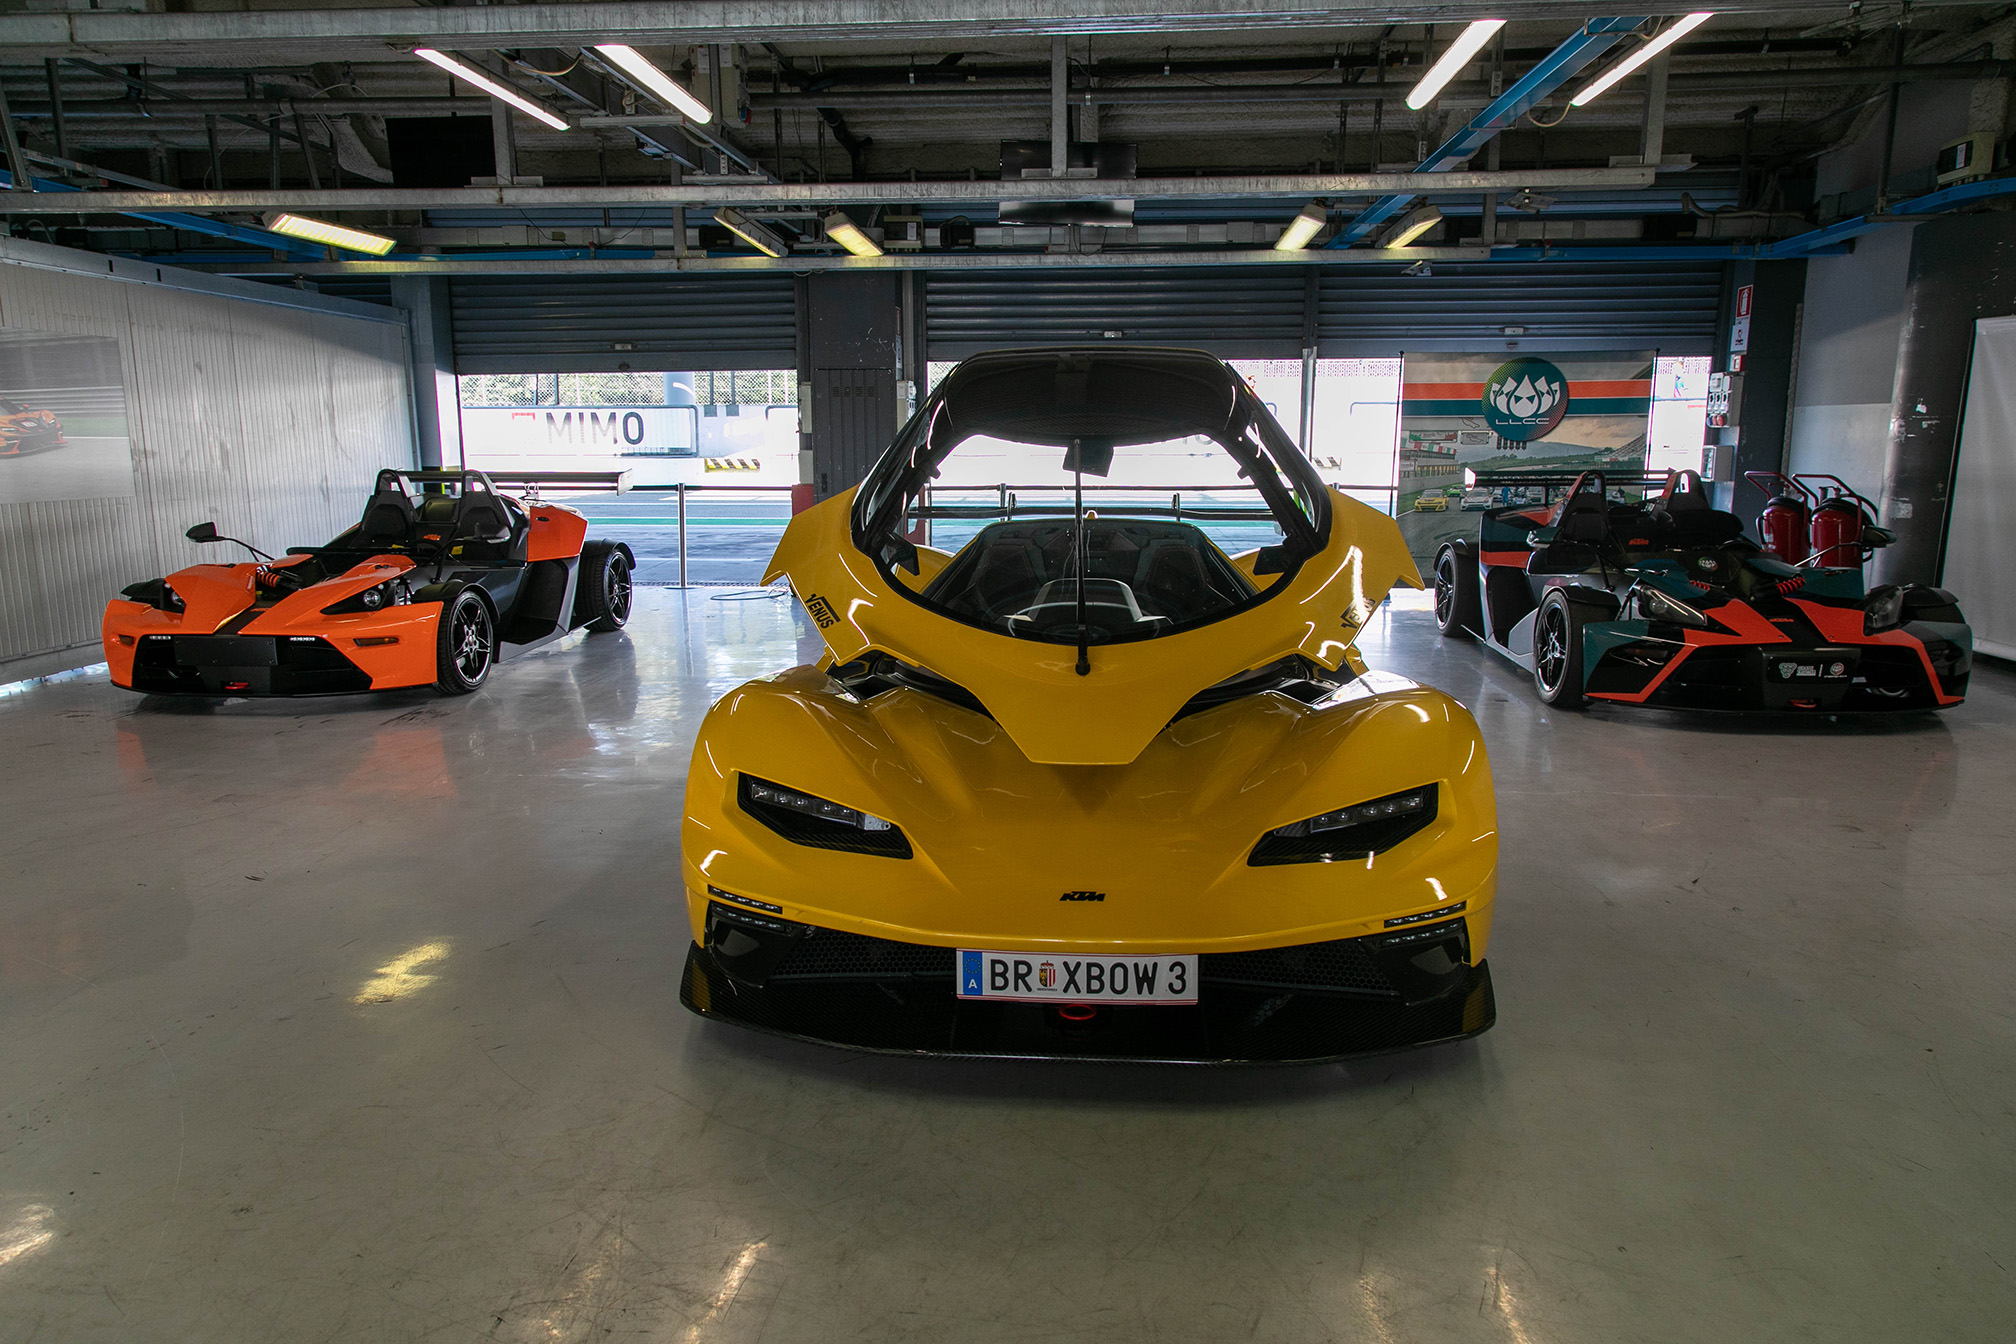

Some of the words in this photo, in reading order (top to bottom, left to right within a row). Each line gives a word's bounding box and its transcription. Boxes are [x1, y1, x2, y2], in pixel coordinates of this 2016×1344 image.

[545, 411, 645, 445] MIMO
[1495, 417, 1550, 425] LLCC
[805, 593, 841, 629] VENUS
[1059, 890, 1106, 902] KTM
[968, 979, 978, 989] A
[990, 958, 1033, 993] BR
[1062, 960, 1158, 996] XBOW
[1167, 961, 1187, 995] 3
